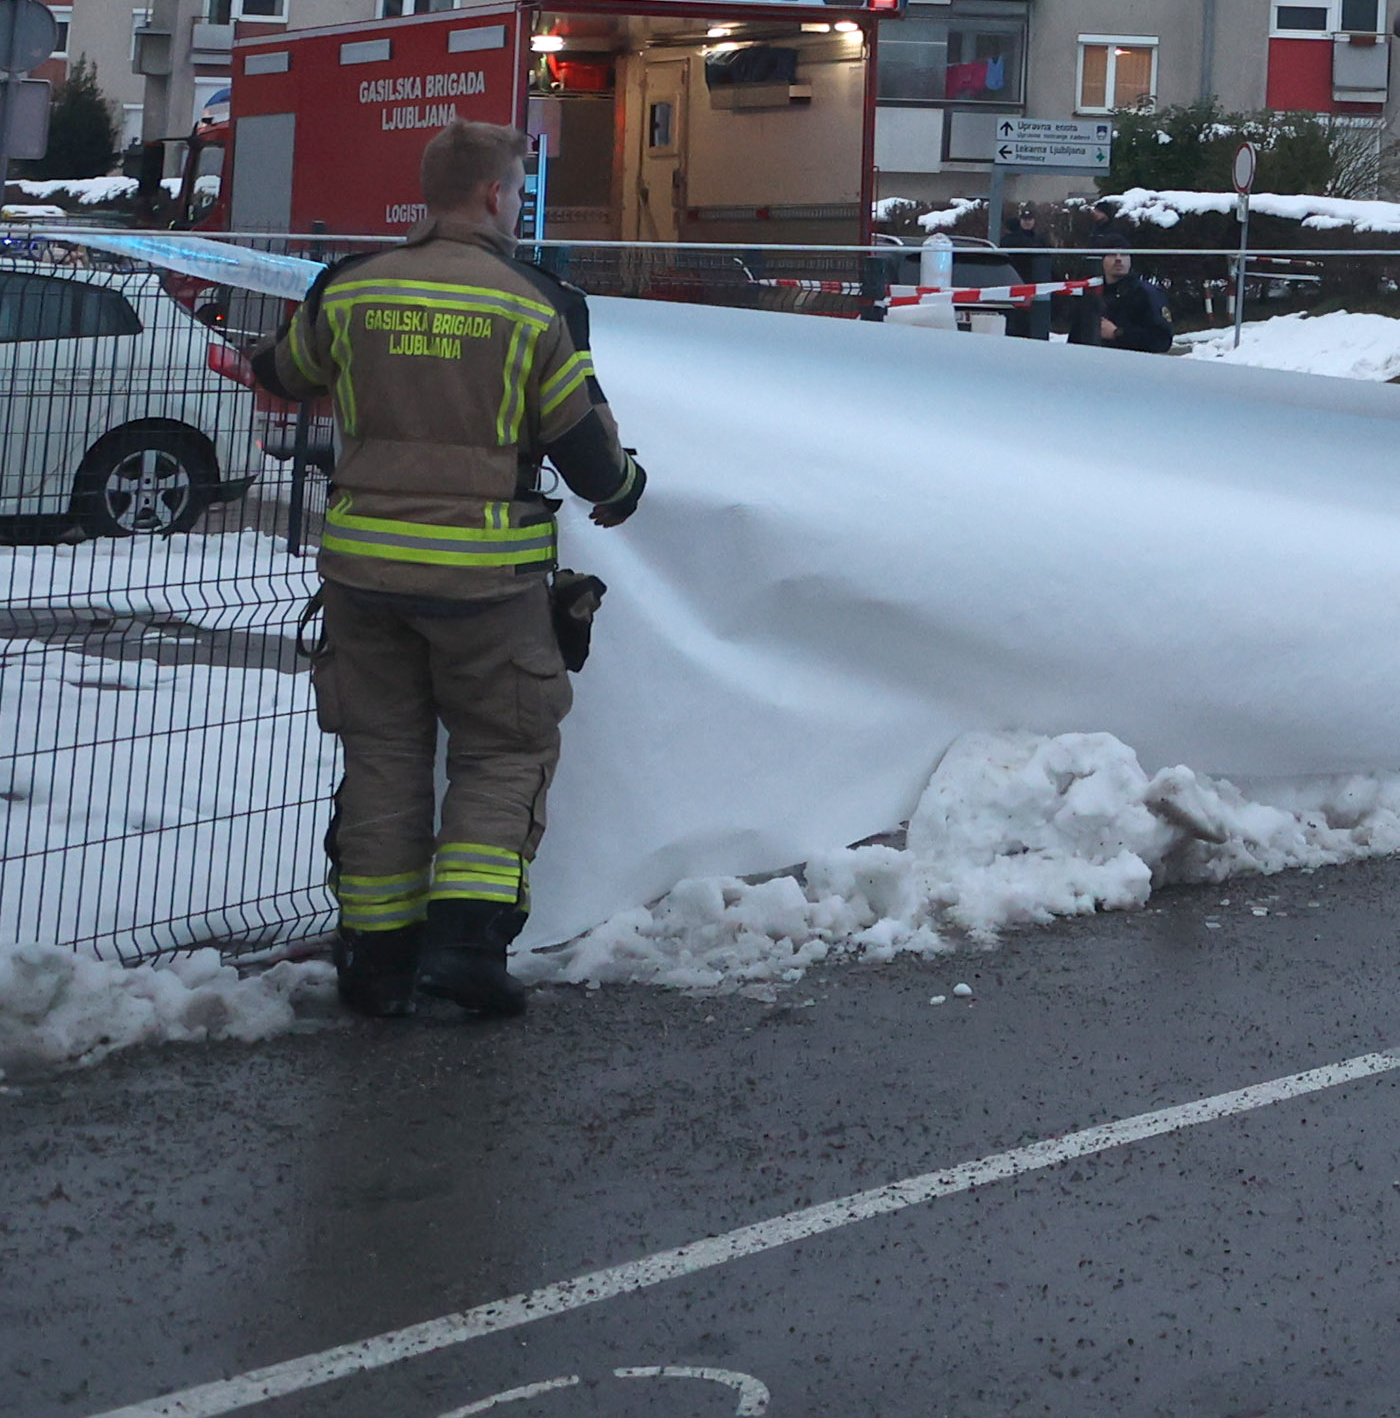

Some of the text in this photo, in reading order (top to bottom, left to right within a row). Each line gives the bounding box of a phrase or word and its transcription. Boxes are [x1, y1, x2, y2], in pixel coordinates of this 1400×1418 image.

[359, 71, 486, 104] GASILSKA BRIGADA
[382, 103, 457, 131] LJUBLJANA
[1049, 145, 1086, 155] Ljubljana
[386, 203, 428, 223] LOGISTI
[365, 309, 492, 339] GASILSKA BRIGADA
[389, 334, 461, 359] LJUBLANA
